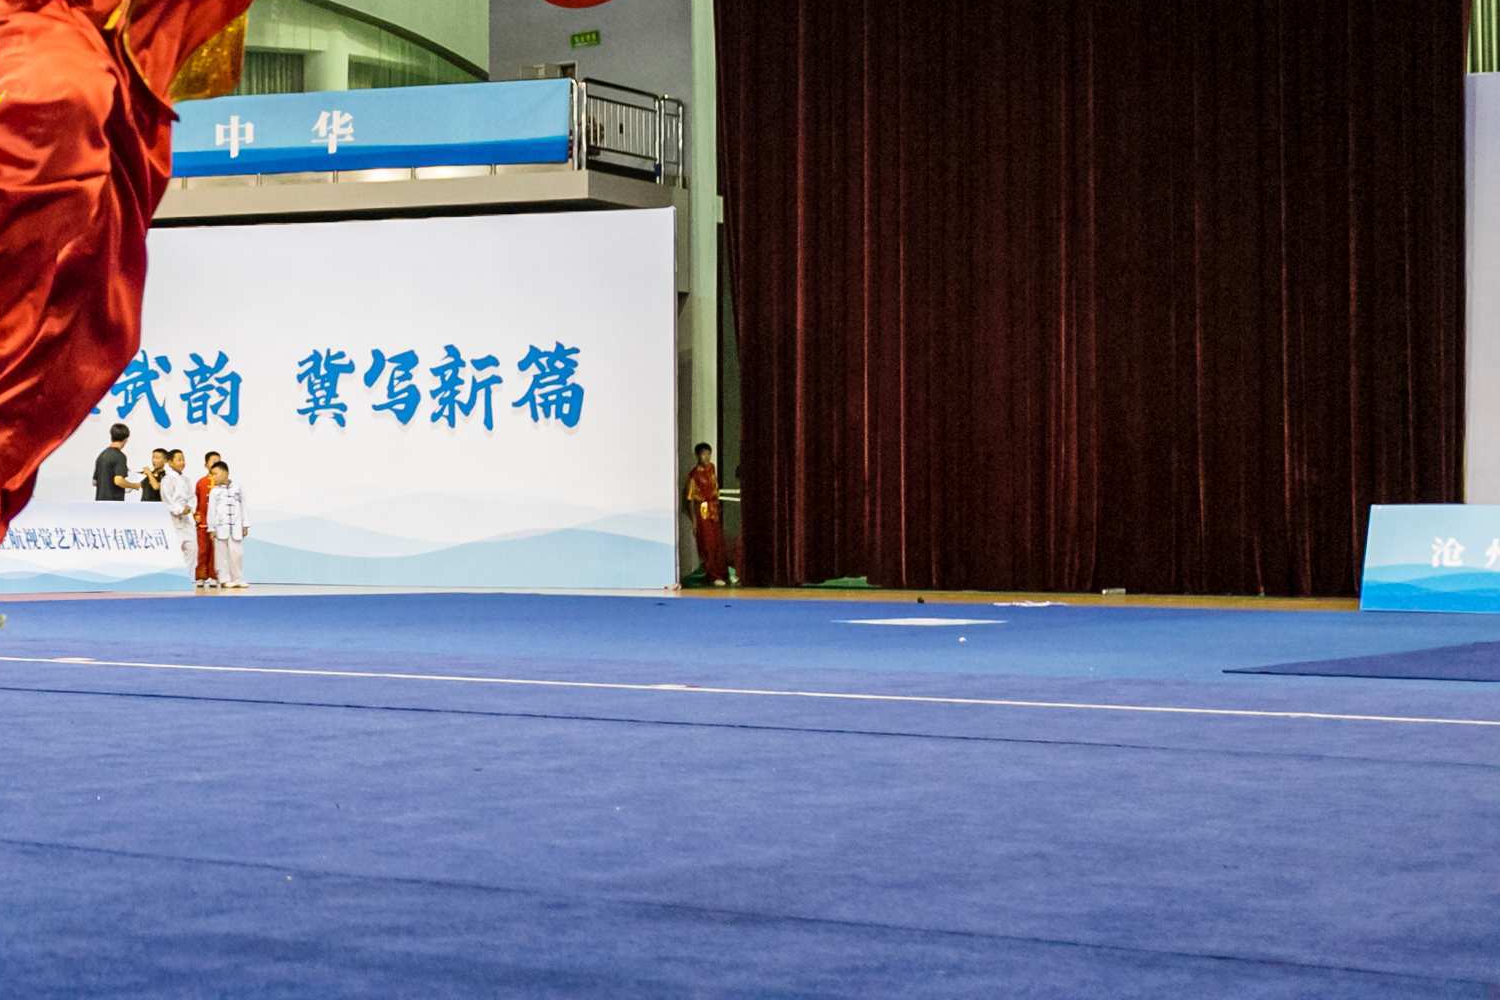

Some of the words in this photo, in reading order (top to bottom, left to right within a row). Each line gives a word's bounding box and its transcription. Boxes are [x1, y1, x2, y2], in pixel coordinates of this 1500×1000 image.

[214, 110, 355, 159] 中华
[297, 341, 585, 431] 冀写新篇
